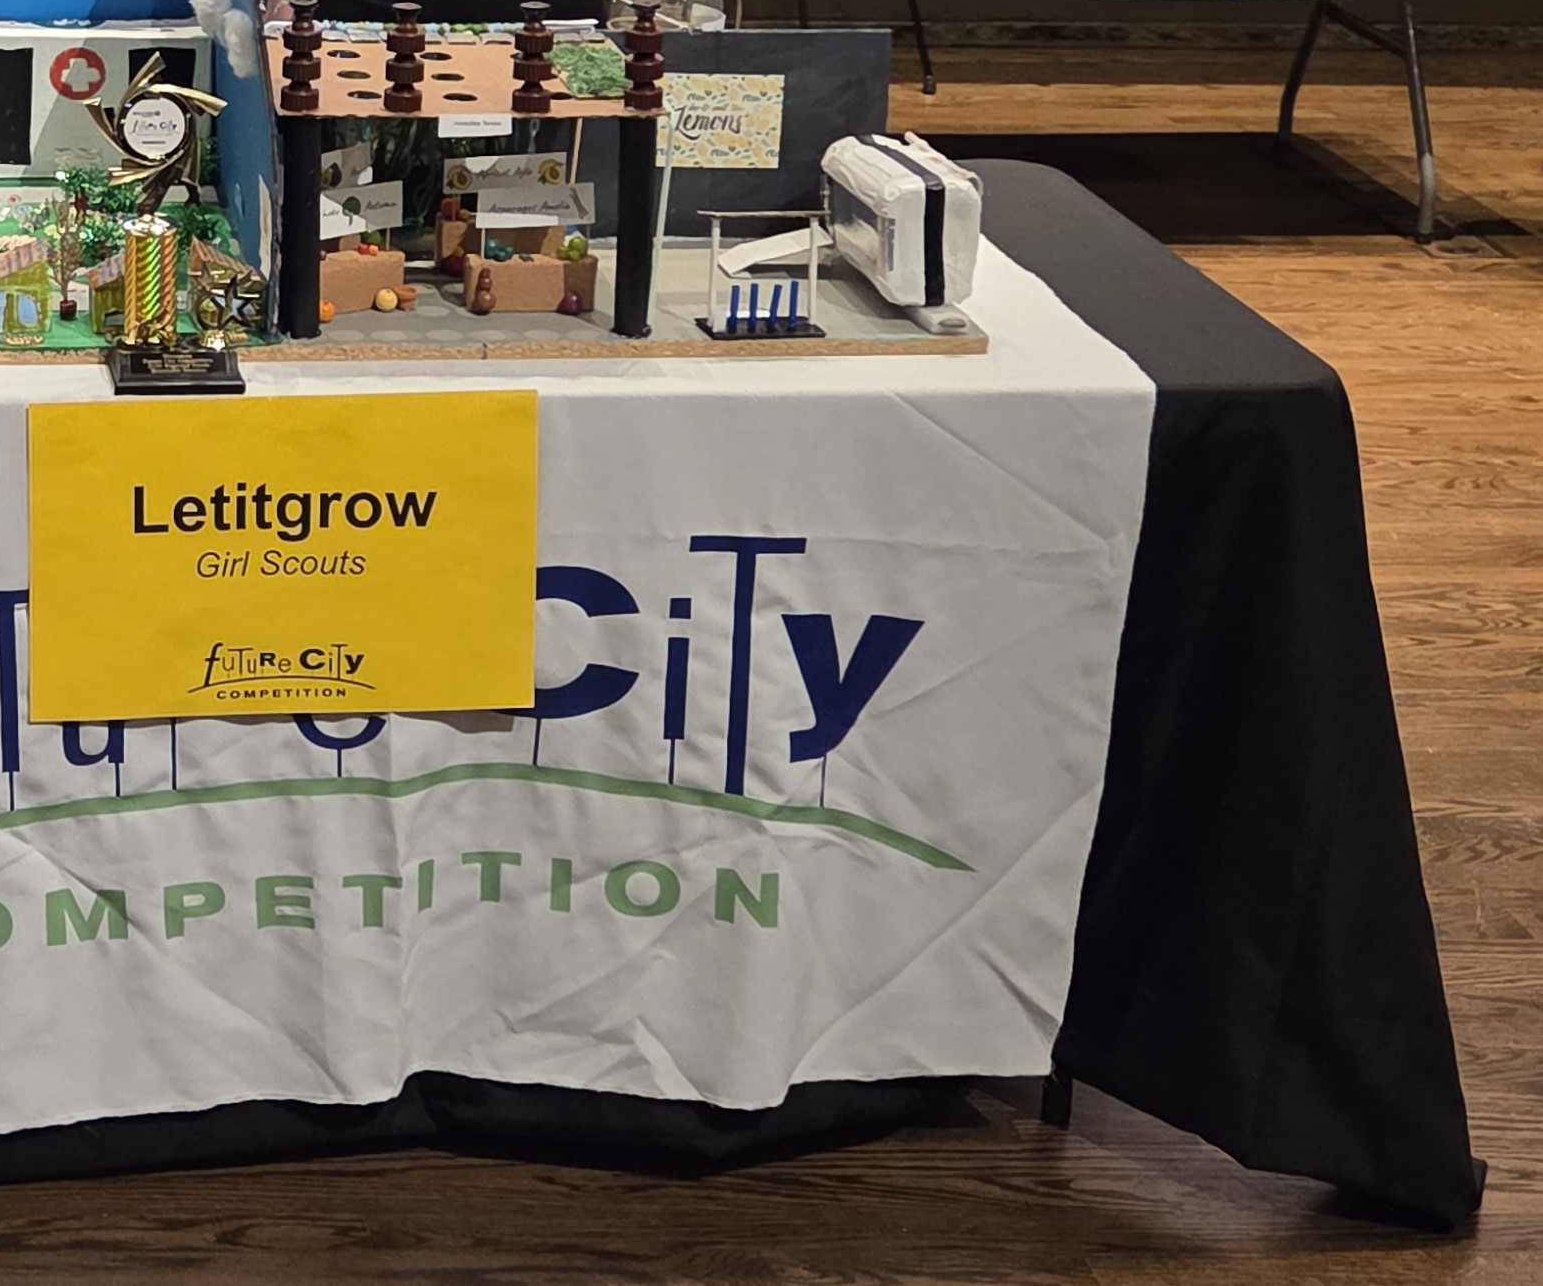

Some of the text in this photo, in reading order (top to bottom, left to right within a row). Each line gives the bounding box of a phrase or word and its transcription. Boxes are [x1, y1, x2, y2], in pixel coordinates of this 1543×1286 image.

[674, 105, 743, 141] Lemons
[132, 482, 438, 542] Letitgrow
[196, 550, 367, 578] Girl Scouts
[215, 687, 348, 700] COMPETITION
